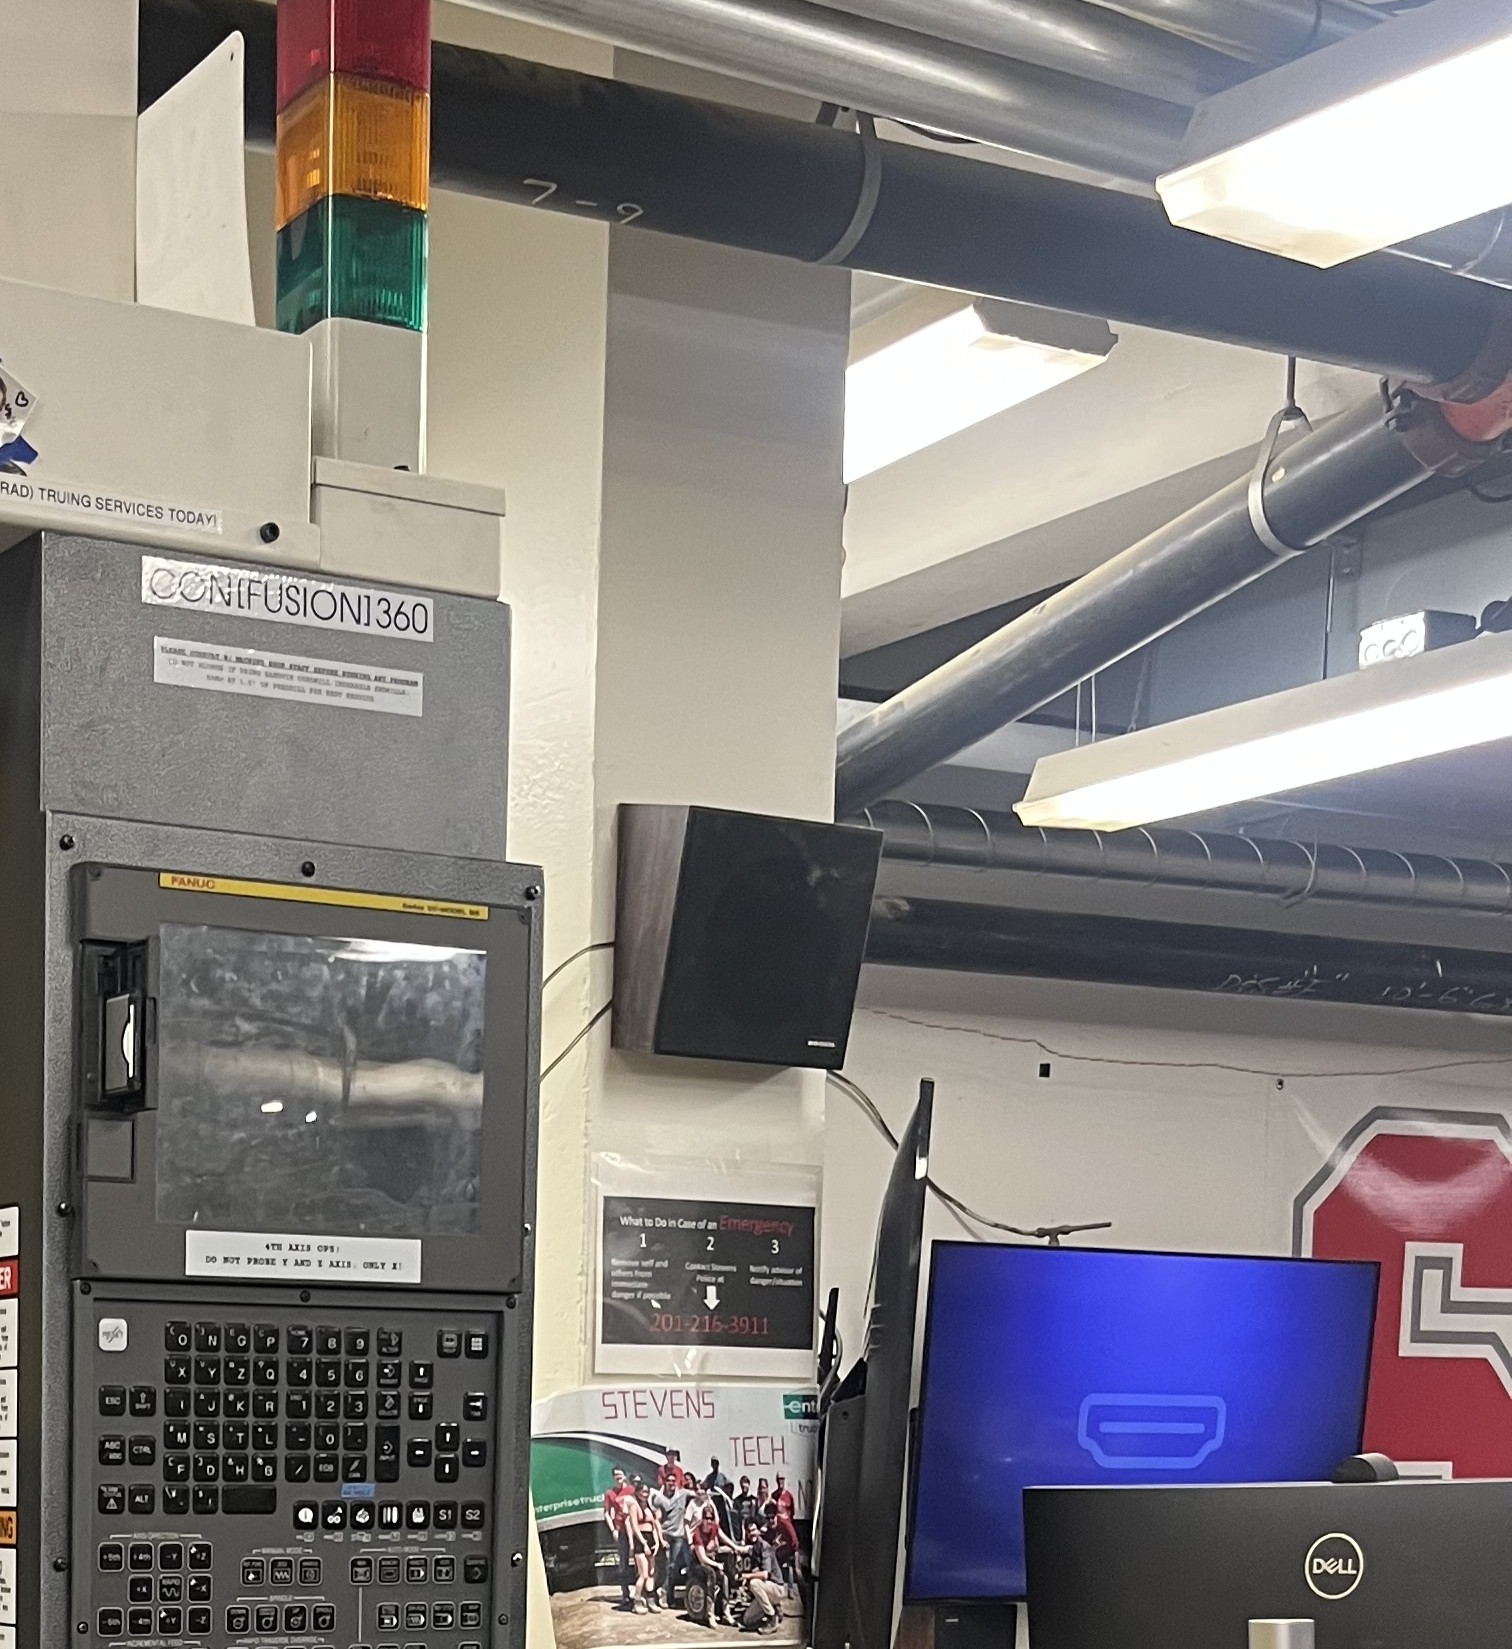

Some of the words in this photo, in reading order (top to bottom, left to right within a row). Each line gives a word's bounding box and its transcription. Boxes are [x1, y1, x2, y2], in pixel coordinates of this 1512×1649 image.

[38, 487, 91, 508] TRUING
[95, 497, 164, 520] SERVICES
[168, 508, 218, 528] TODAY!
[171, 876, 216, 889] FANUC
[620, 1216, 644, 1228] What
[644, 1217, 654, 1227] to
[655, 1218, 667, 1228] Do
[668, 1218, 676, 1228] in
[677, 1219, 696, 1229] Case
[697, 1219, 707, 1229] of
[707, 1222, 718, 1230] an
[719, 1215, 795, 1237] Emergency
[640, 1233, 647, 1248] 1
[707, 1236, 715, 1250] 2
[288, 1244, 311, 1252] AXIS
[771, 1239, 780, 1254] 3
[223, 1256, 241, 1264] NOT
[247, 1257, 276, 1266] PROBE
[282, 1258, 288, 1266] Y
[294, 1259, 312, 1267] AND
[363, 1261, 386, 1270] ONLY
[648, 1313, 768, 1335] 201-216-3911
[178, 1334, 187, 1346] O
[208, 1335, 217, 1346] N
[238, 1335, 247, 1347] G
[266, 1337, 275, 1348] P
[301, 1337, 309, 1348] 7
[328, 1338, 337, 1349] 8
[356, 1339, 365, 1349] 9
[178, 1367, 187, 1378] X
[208, 1368, 216, 1379] Y
[238, 1368, 246, 1380] Z
[266, 1369, 275, 1380] Q
[299, 1369, 307, 1379] 4
[327, 1370, 335, 1381] 5
[355, 1370, 364, 1381] 6
[207, 1401, 216, 1412] J
[237, 1400, 245, 1411] K
[302, 1400, 307, 1411] 1
[326, 1401, 335, 1411] 2
[355, 1401, 363, 1412] 3
[601, 1390, 715, 1419] STEVENS
[177, 1432, 187, 1443] M
[207, 1433, 216, 1444] S
[236, 1433, 245, 1444] T
[265, 1434, 273, 1445] L
[326, 1434, 335, 1445] 0
[729, 1435, 786, 1467] TECH
[177, 1464, 185, 1475] F
[206, 1465, 215, 1476] D
[236, 1465, 245, 1476] H
[264, 1465, 273, 1476] B
[439, 1509, 452, 1520] S1
[466, 1509, 481, 1520] S2
[1312, 1557, 1357, 1575] DELL
